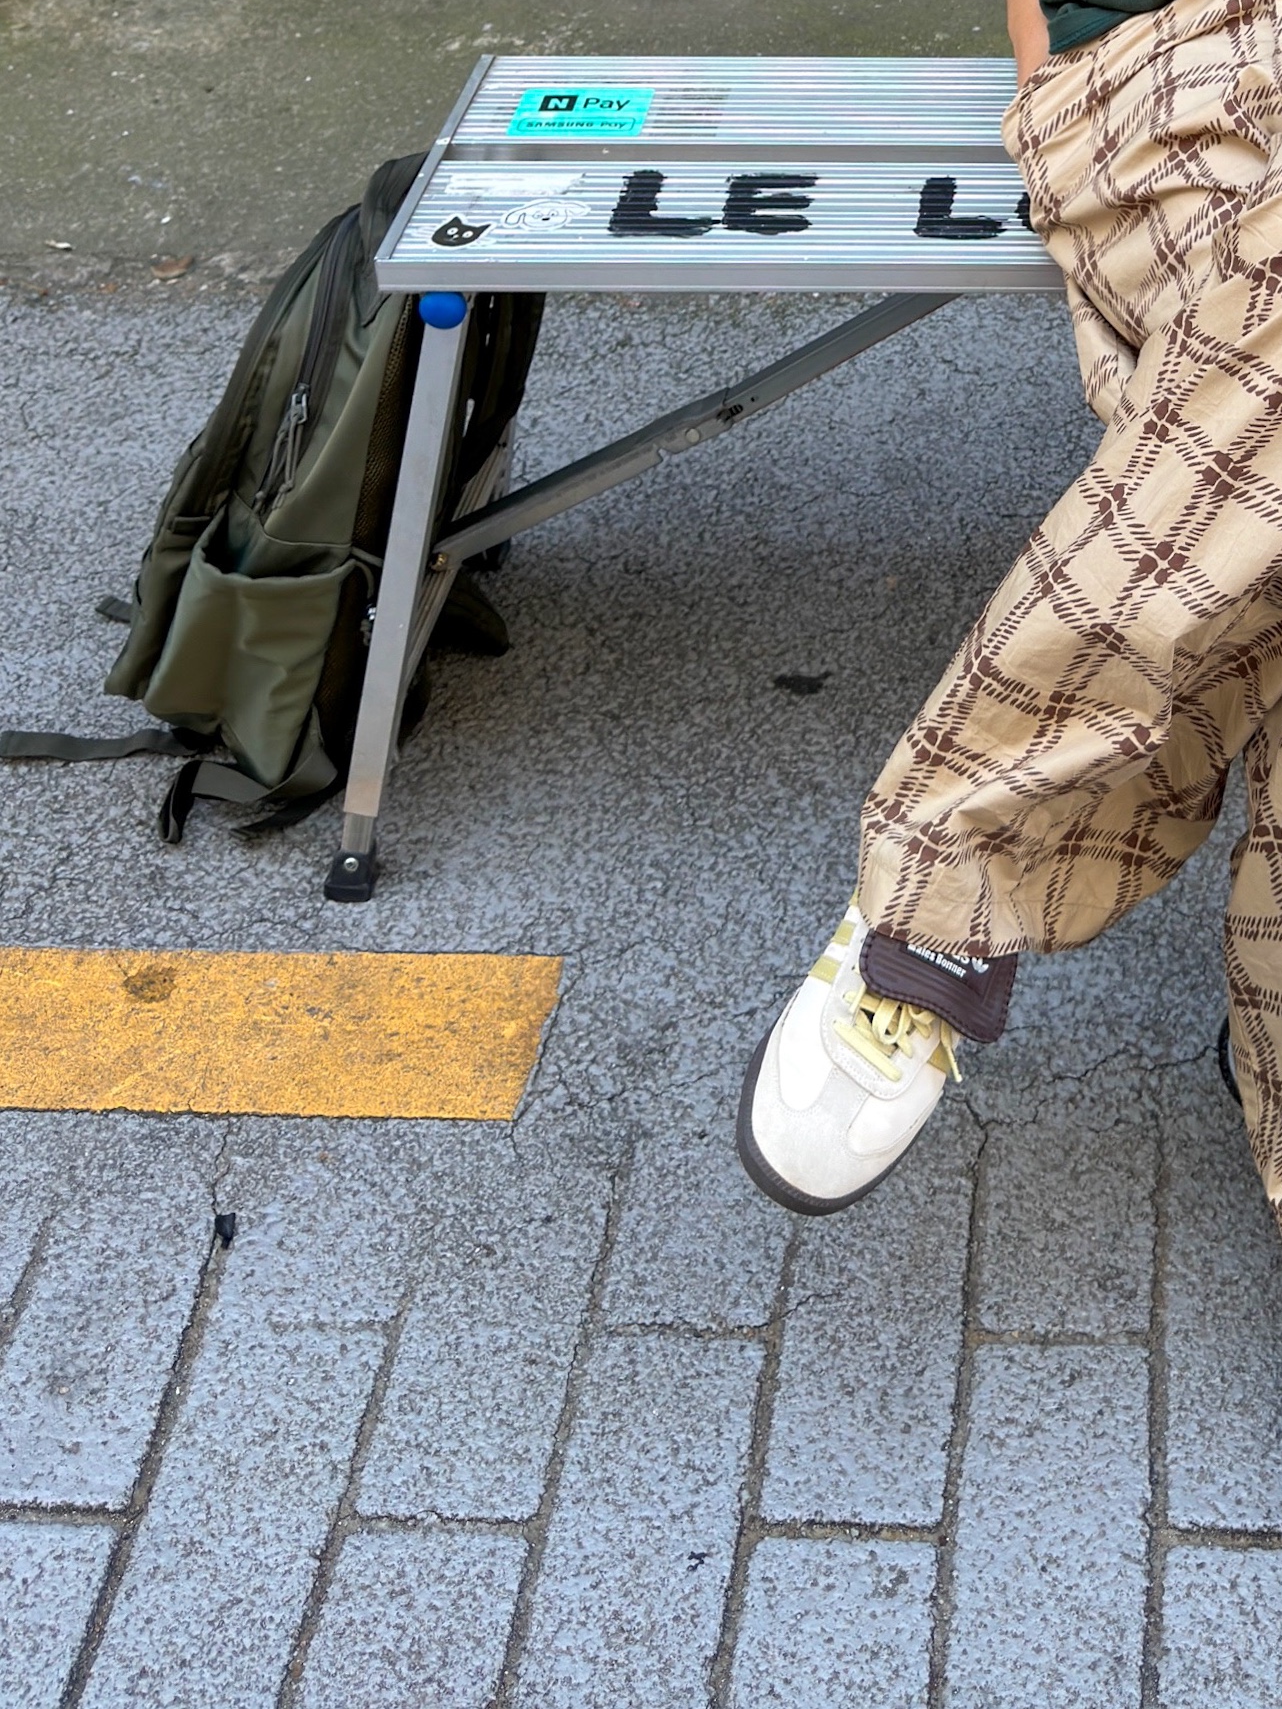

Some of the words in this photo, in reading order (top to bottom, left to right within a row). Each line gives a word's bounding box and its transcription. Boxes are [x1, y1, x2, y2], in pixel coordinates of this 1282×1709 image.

[583, 97, 630, 111] Pay
[525, 120, 594, 129] SAMSUNG
[608, 170, 823, 237] LE
